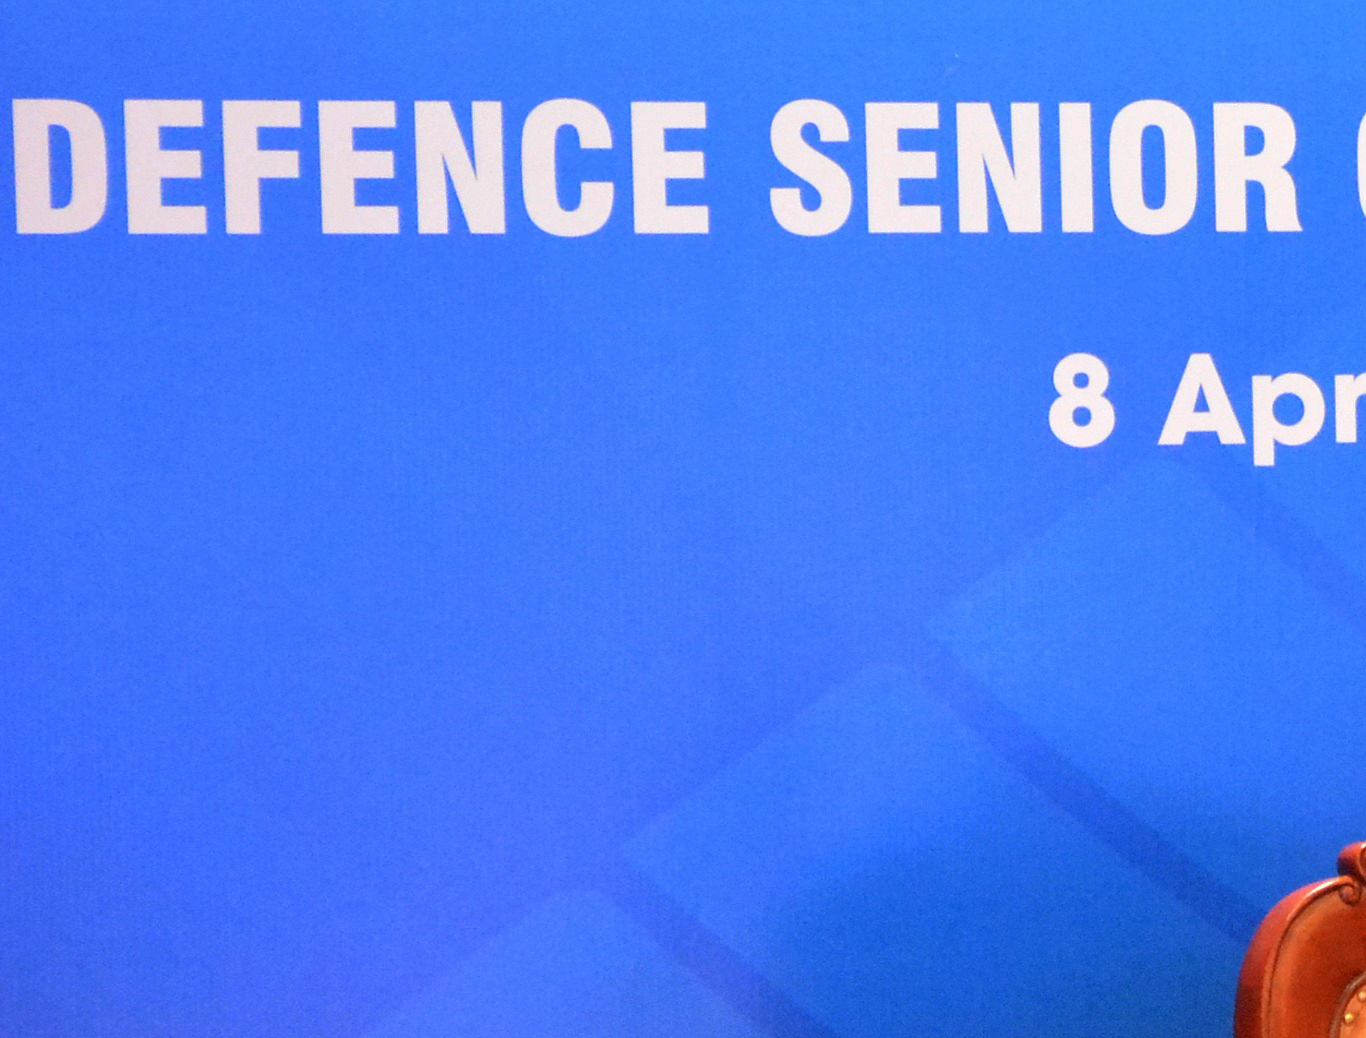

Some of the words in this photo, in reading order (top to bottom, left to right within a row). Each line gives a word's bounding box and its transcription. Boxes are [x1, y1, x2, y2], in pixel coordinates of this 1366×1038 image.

[13, 98, 709, 237] DEFENCE
[770, 99, 1302, 236] SENIOR
[1049, 353, 1115, 448] 8
